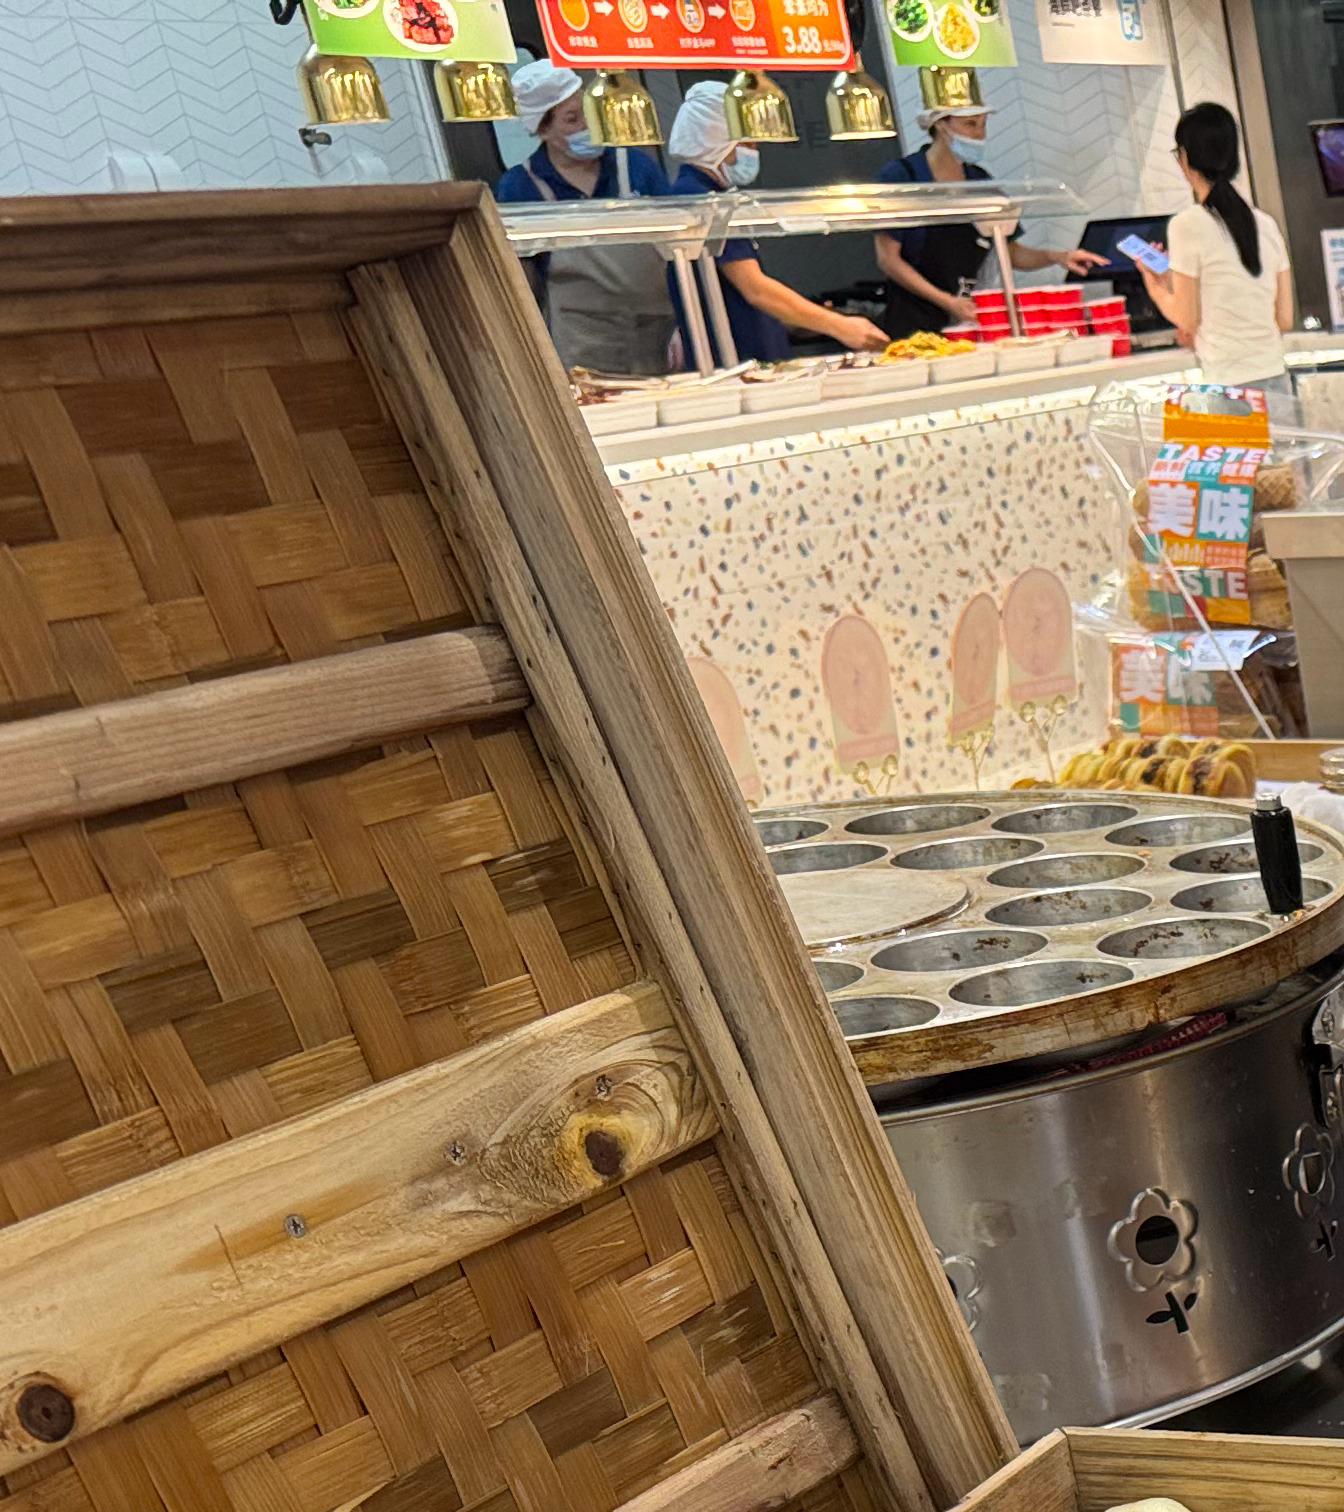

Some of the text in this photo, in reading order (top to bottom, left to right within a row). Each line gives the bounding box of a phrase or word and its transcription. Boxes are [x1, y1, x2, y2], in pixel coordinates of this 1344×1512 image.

[781, 26, 822, 54] 3.88
[1161, 443, 1267, 464] TASTE
[1148, 483, 1250, 540] 美味
